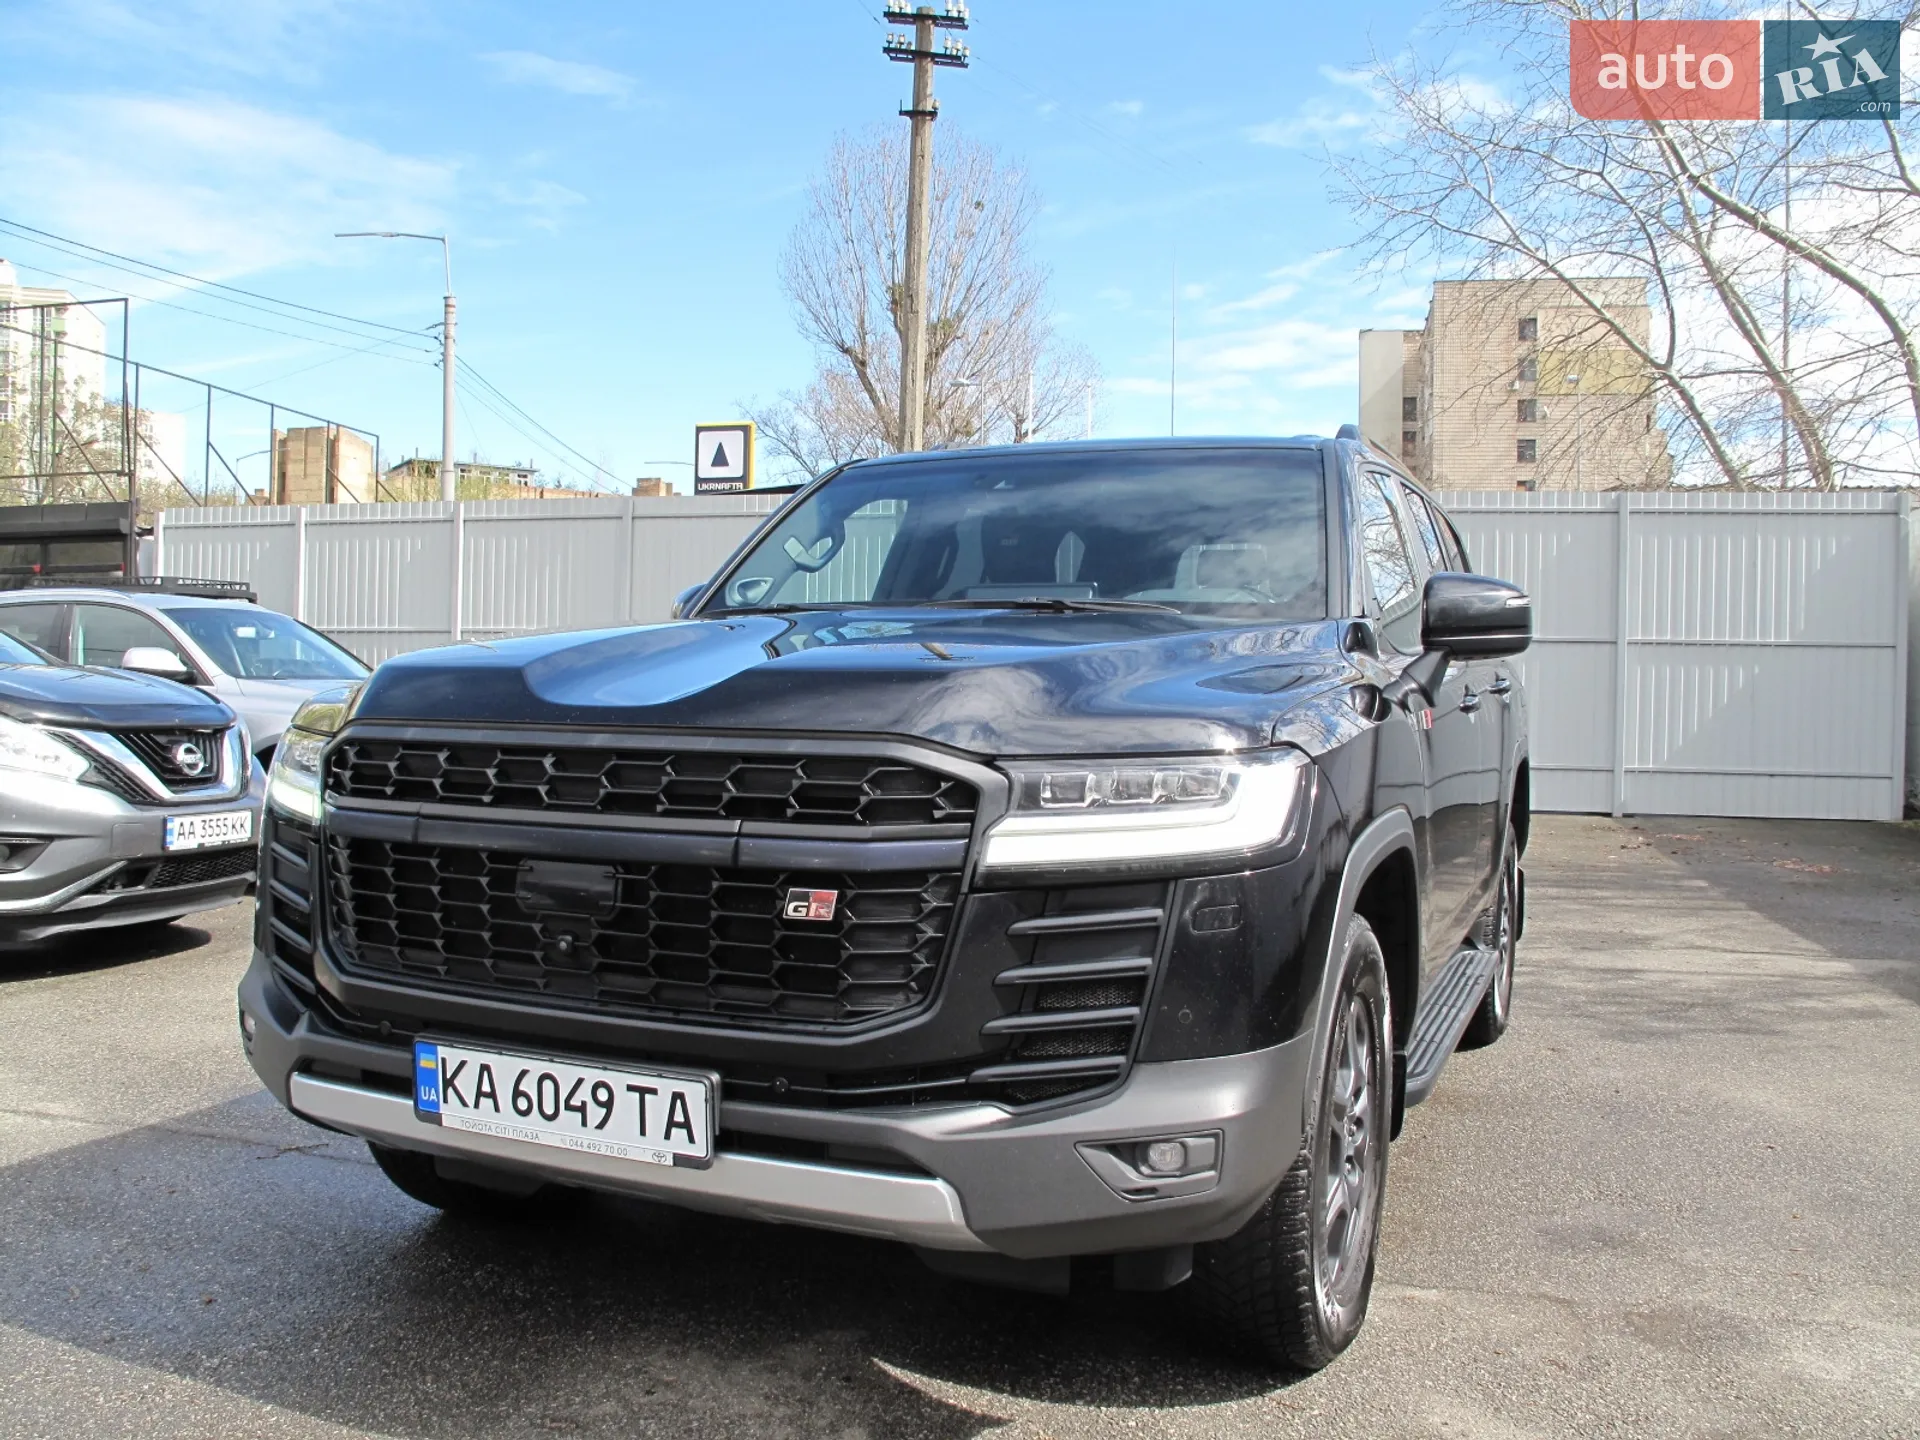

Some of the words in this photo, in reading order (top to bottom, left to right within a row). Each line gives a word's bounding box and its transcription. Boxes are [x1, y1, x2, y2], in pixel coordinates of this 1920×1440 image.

[697, 482, 743, 491] UKRNAFTA
[177, 821, 196, 841] AA
[200, 817, 229, 838] 3555
[231, 815, 248, 835] KK
[787, 901, 831, 917] GR
[421, 1086, 438, 1103] UA
[440, 1056, 500, 1113] KA
[511, 1068, 615, 1130] 6049
[626, 1082, 697, 1145] TA
[568, 1138, 584, 1149] 044
[586, 1142, 602, 1152] 492
[604, 1144, 615, 1154] 70
[616, 1147, 628, 1157] 00
